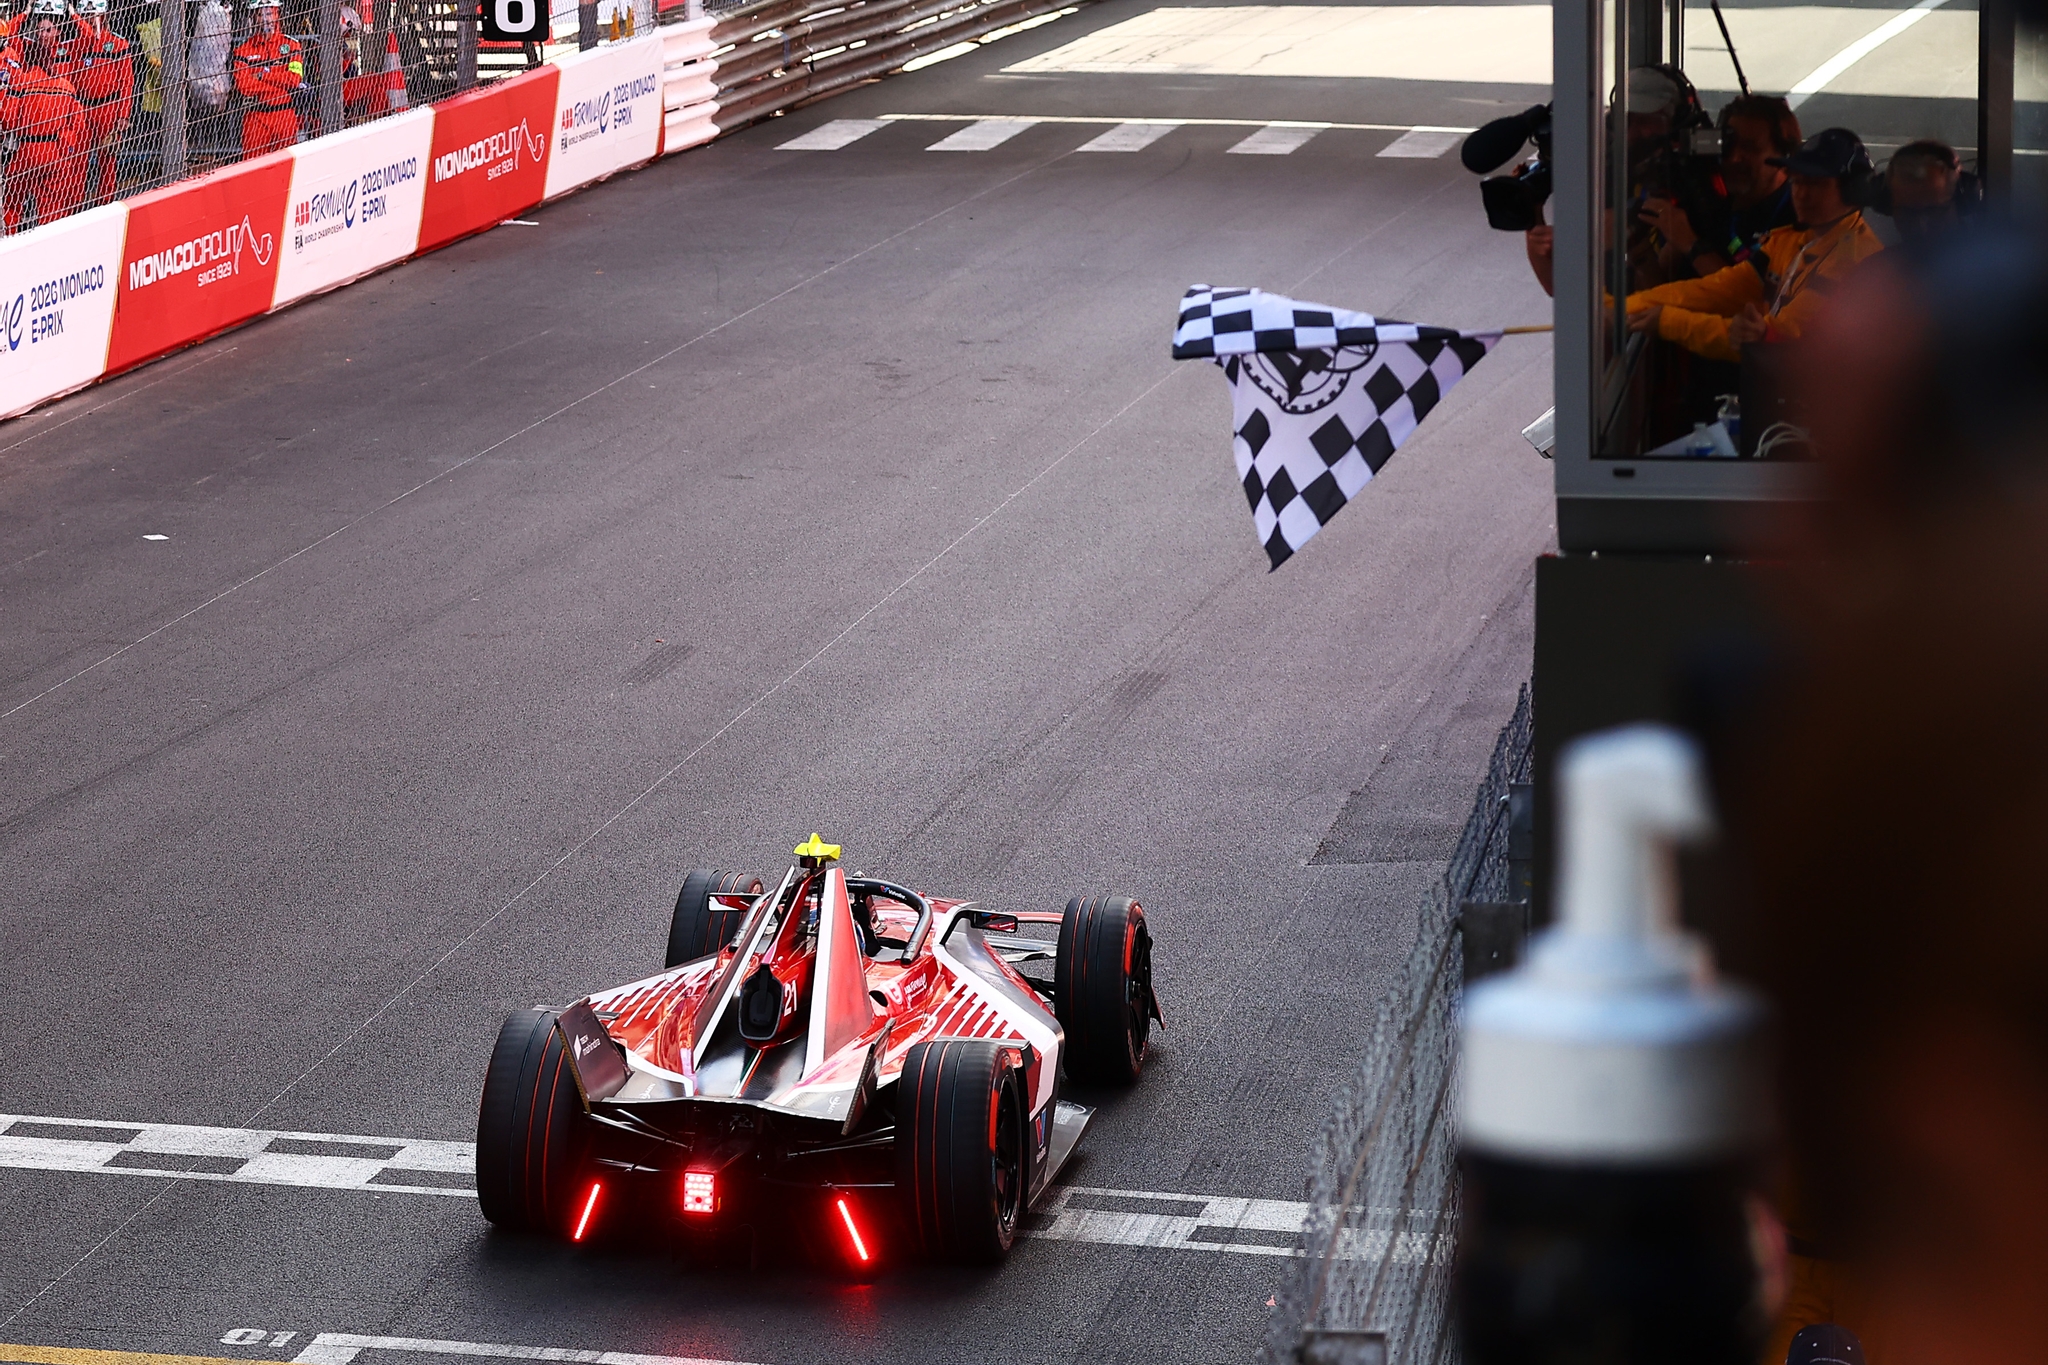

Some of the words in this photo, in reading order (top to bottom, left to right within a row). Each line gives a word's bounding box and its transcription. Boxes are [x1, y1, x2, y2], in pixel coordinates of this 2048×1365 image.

[614, 83, 629, 106] 2026
[630, 73, 655, 99] MONACO
[362, 169, 382, 196] 2026
[383, 157, 416, 188] MONACO
[487, 164, 501, 181] SINCE
[295, 201, 310, 228] ABB
[362, 194, 387, 223] E-PRIX
[31, 280, 58, 312] 2026
[60, 264, 104, 302] MONACO
[197, 268, 216, 287] SINCE
[216, 261, 232, 279] 1929
[32, 309, 64, 344] E-PRIX
[784, 979, 797, 1017] 21
[219, 1328, 298, 1347] 01
